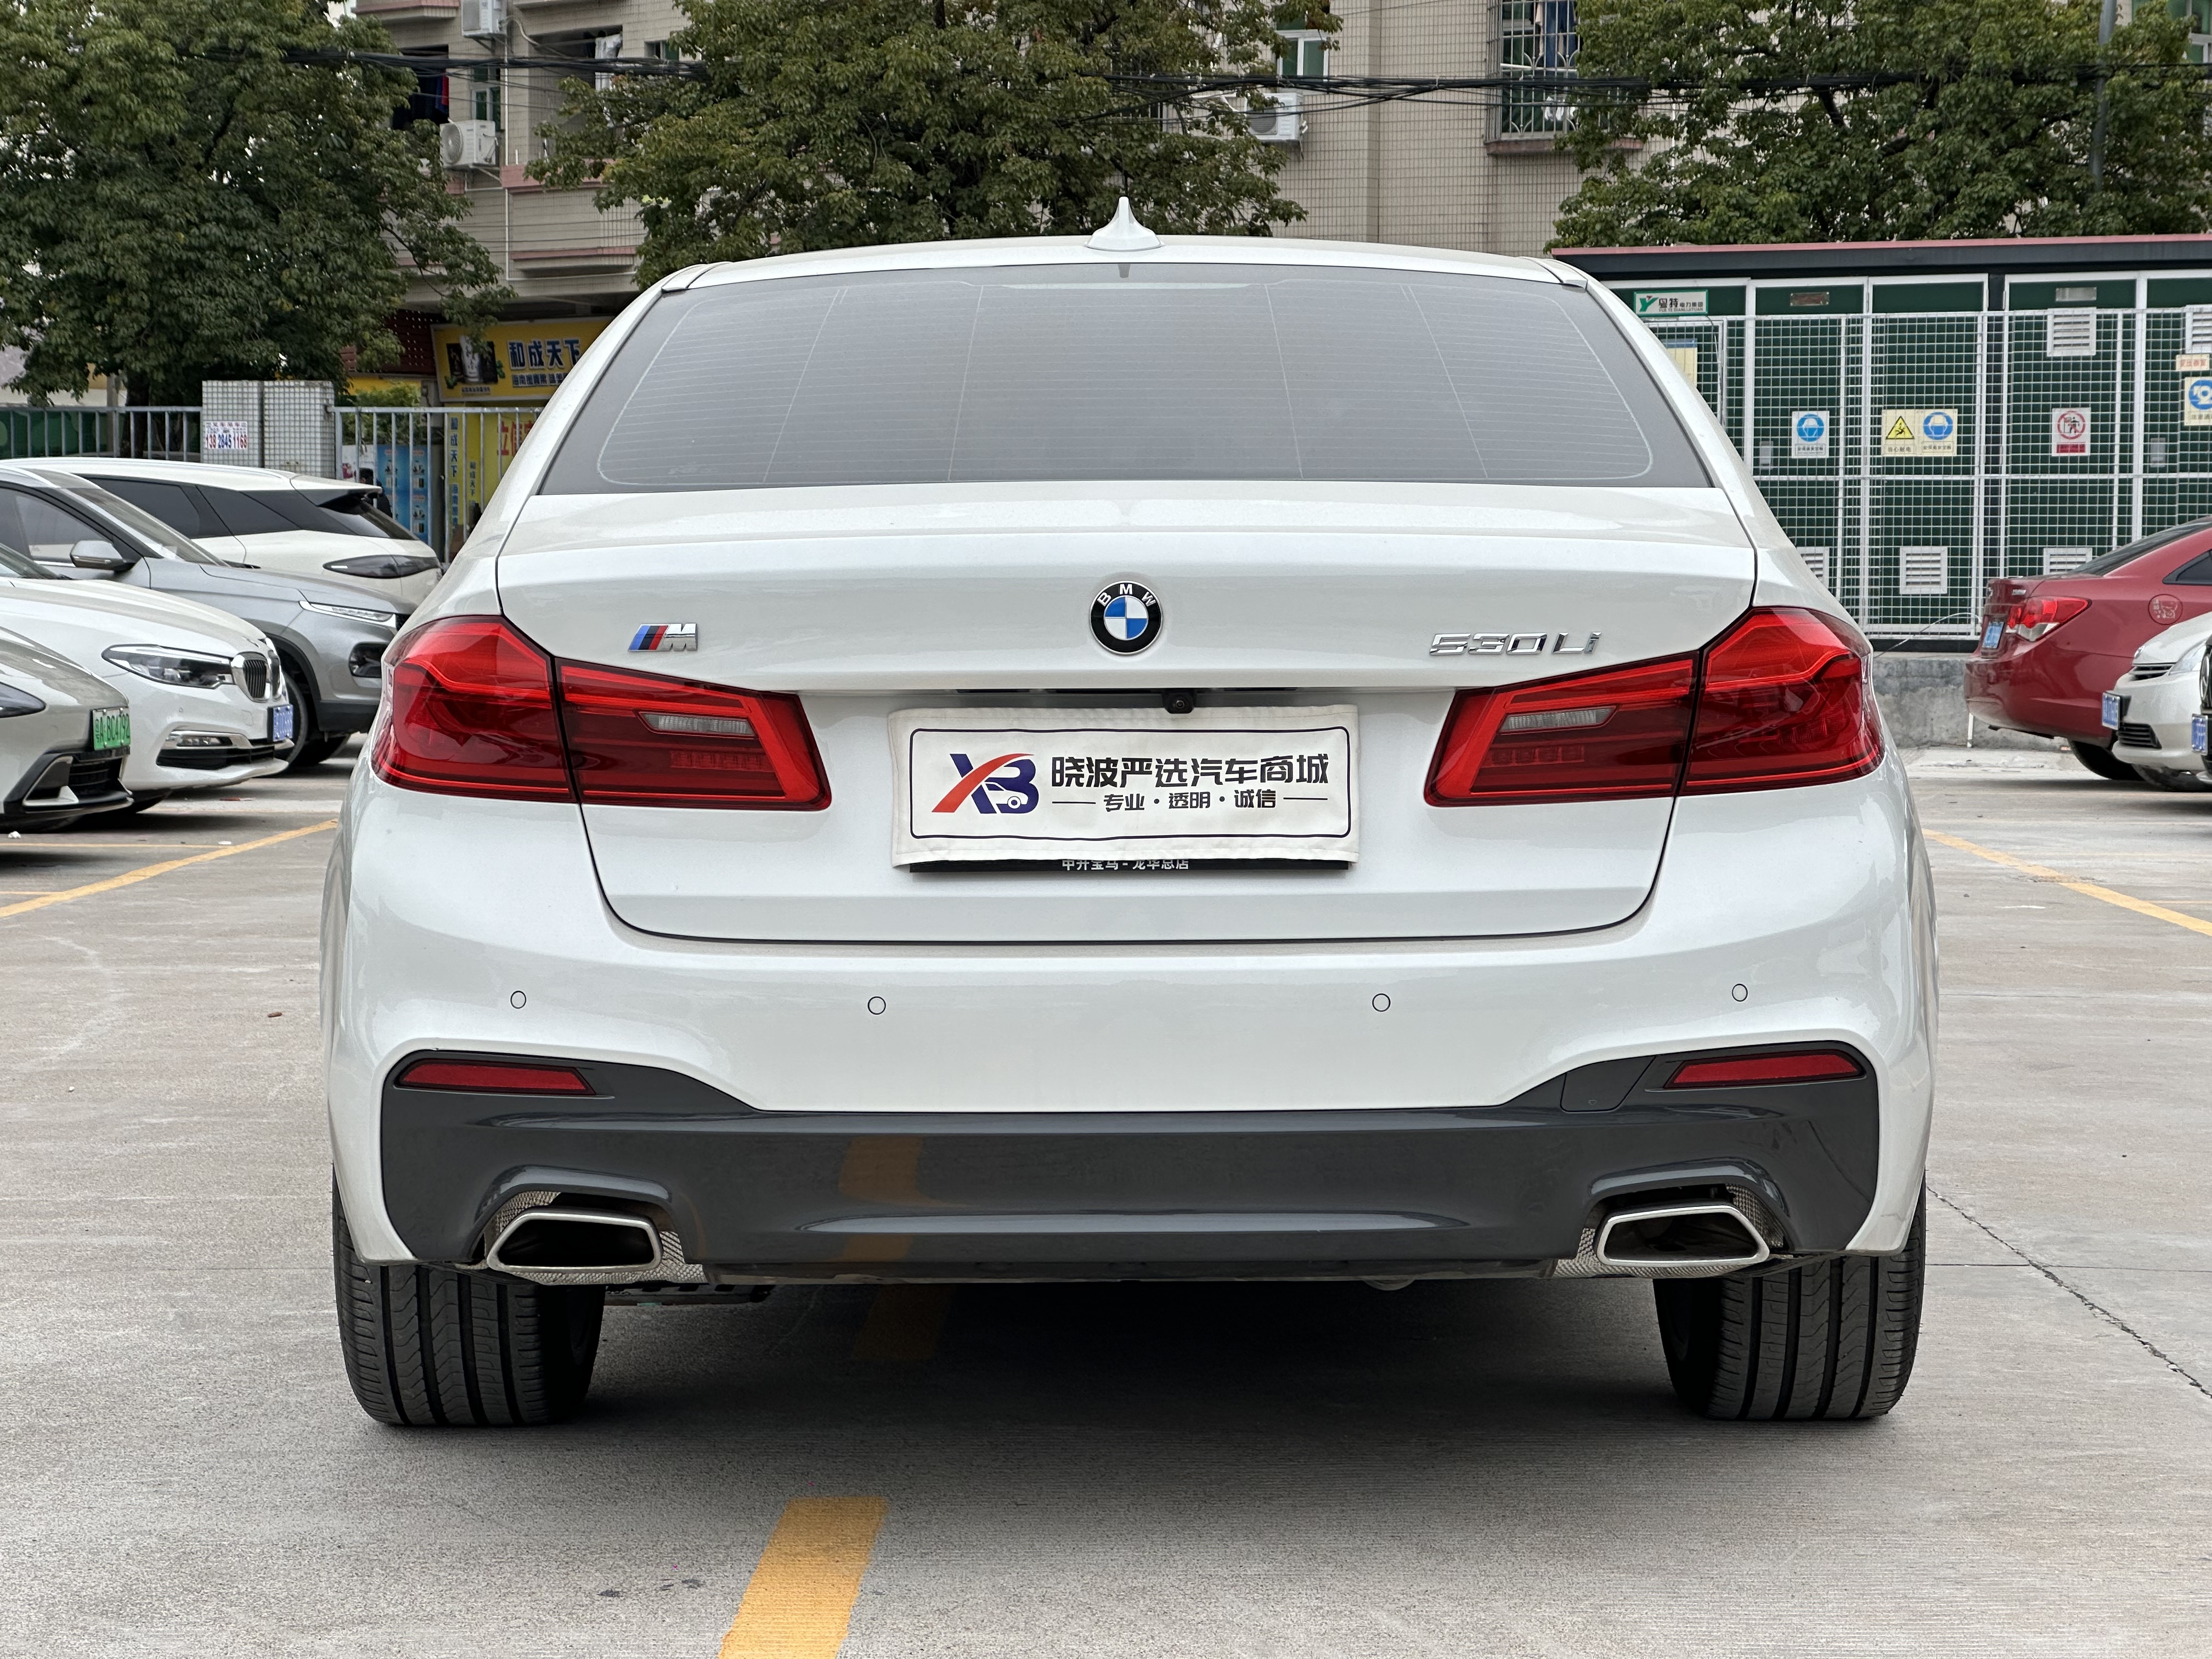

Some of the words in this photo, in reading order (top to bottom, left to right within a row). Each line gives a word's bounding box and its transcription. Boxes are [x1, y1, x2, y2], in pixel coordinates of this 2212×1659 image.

[507, 338, 581, 369] 和成天下
[1097, 584, 1156, 607] BMW
[1429, 632, 1601, 655] 530Li
[1052, 754, 1329, 788] 晓波严选汽车商城
